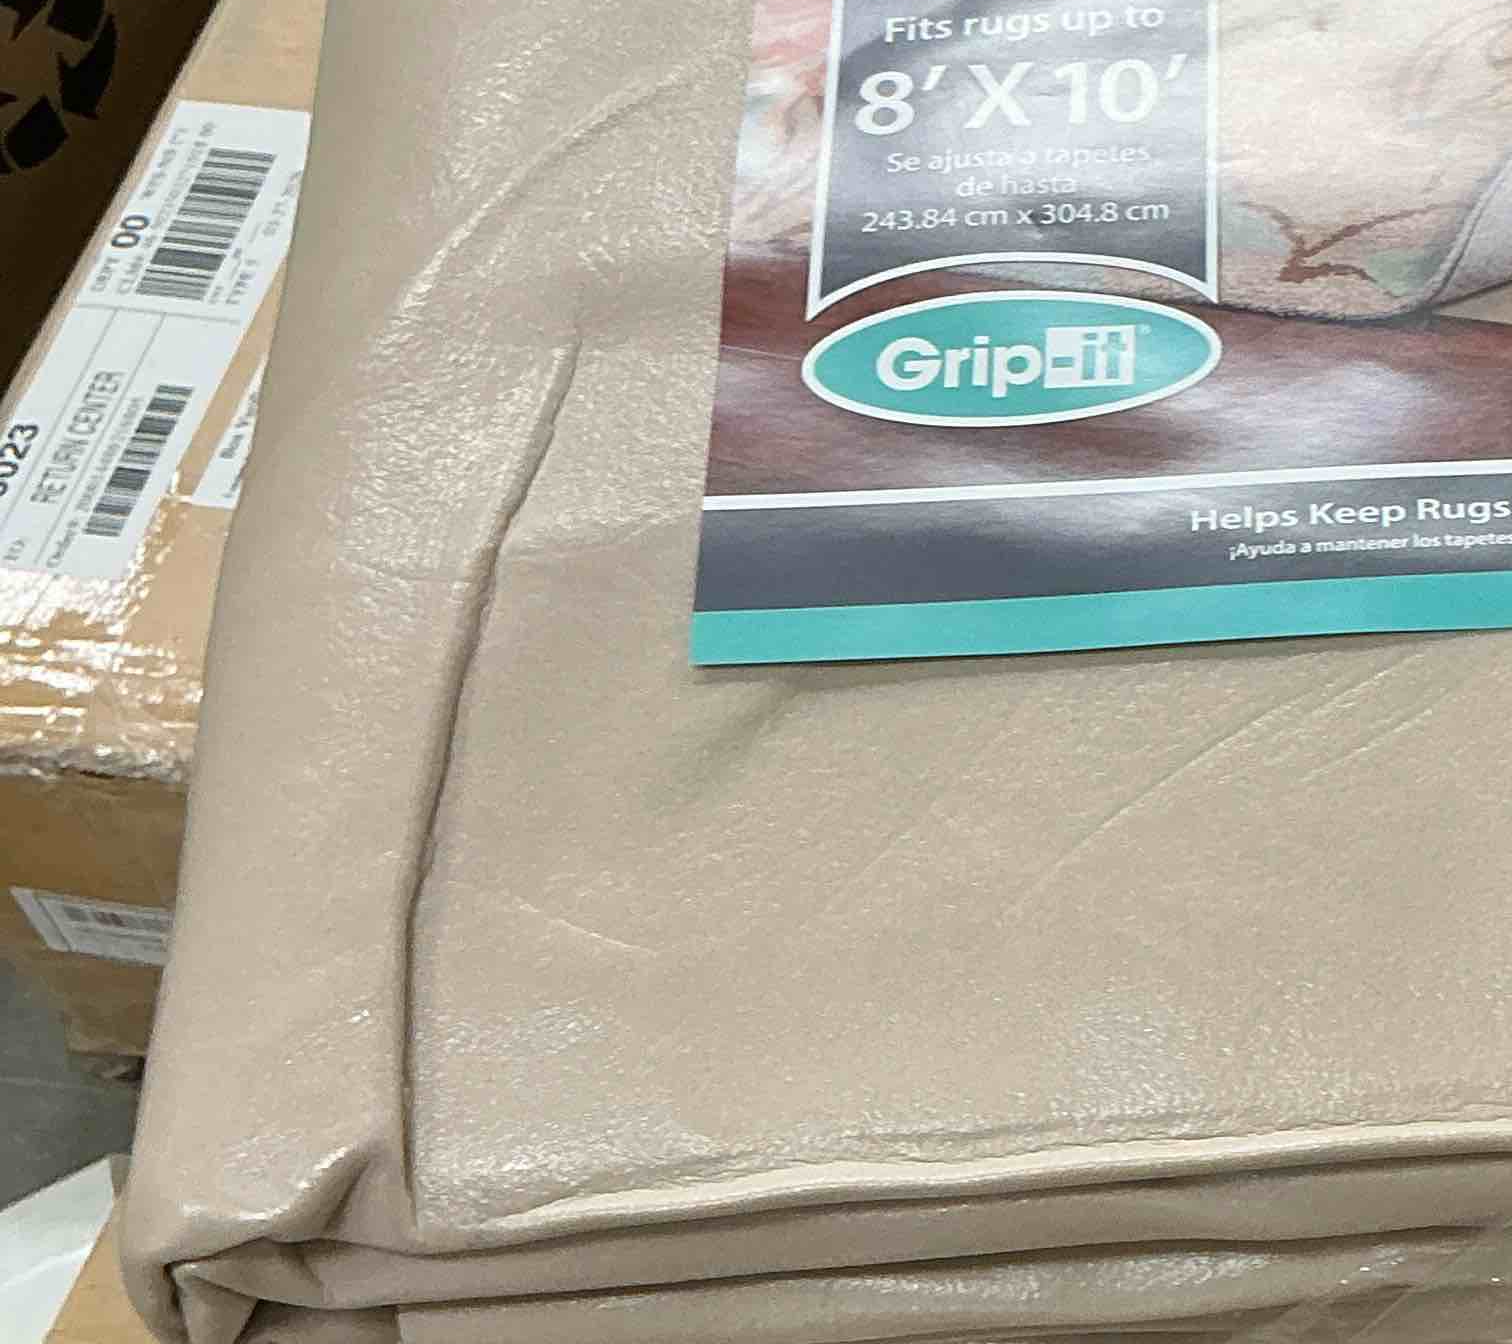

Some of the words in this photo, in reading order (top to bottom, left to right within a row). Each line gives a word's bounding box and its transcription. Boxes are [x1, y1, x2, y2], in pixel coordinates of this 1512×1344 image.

[884, 15, 953, 44] Fits
[964, 10, 1051, 41] rugs
[1062, 9, 1109, 38] up
[1125, 4, 1166, 29] to
[854, 64, 947, 136] 8'
[963, 61, 1035, 130] X
[1054, 53, 1188, 125] 10'
[887, 152, 922, 174] Se
[927, 147, 1011, 175] ajusta
[955, 175, 994, 198] de
[1000, 173, 1078, 196] hasta
[861, 206, 958, 234] 243.84
[963, 209, 1008, 227] cm
[1015, 210, 1033, 225] x
[1039, 202, 1120, 225] 304.8
[1125, 203, 1170, 221] cm
[30, 435, 82, 504] RETURN
[67, 369, 126, 440] CENTER
[0, 423, 39, 498] 023
[1189, 505, 1299, 534] Helps
[1309, 502, 1407, 528] Keep
[1416, 497, 1512, 525] Rugs
[1299, 544, 1312, 554] a
[1315, 536, 1409, 554] mantener
[1413, 533, 1441, 548] los
